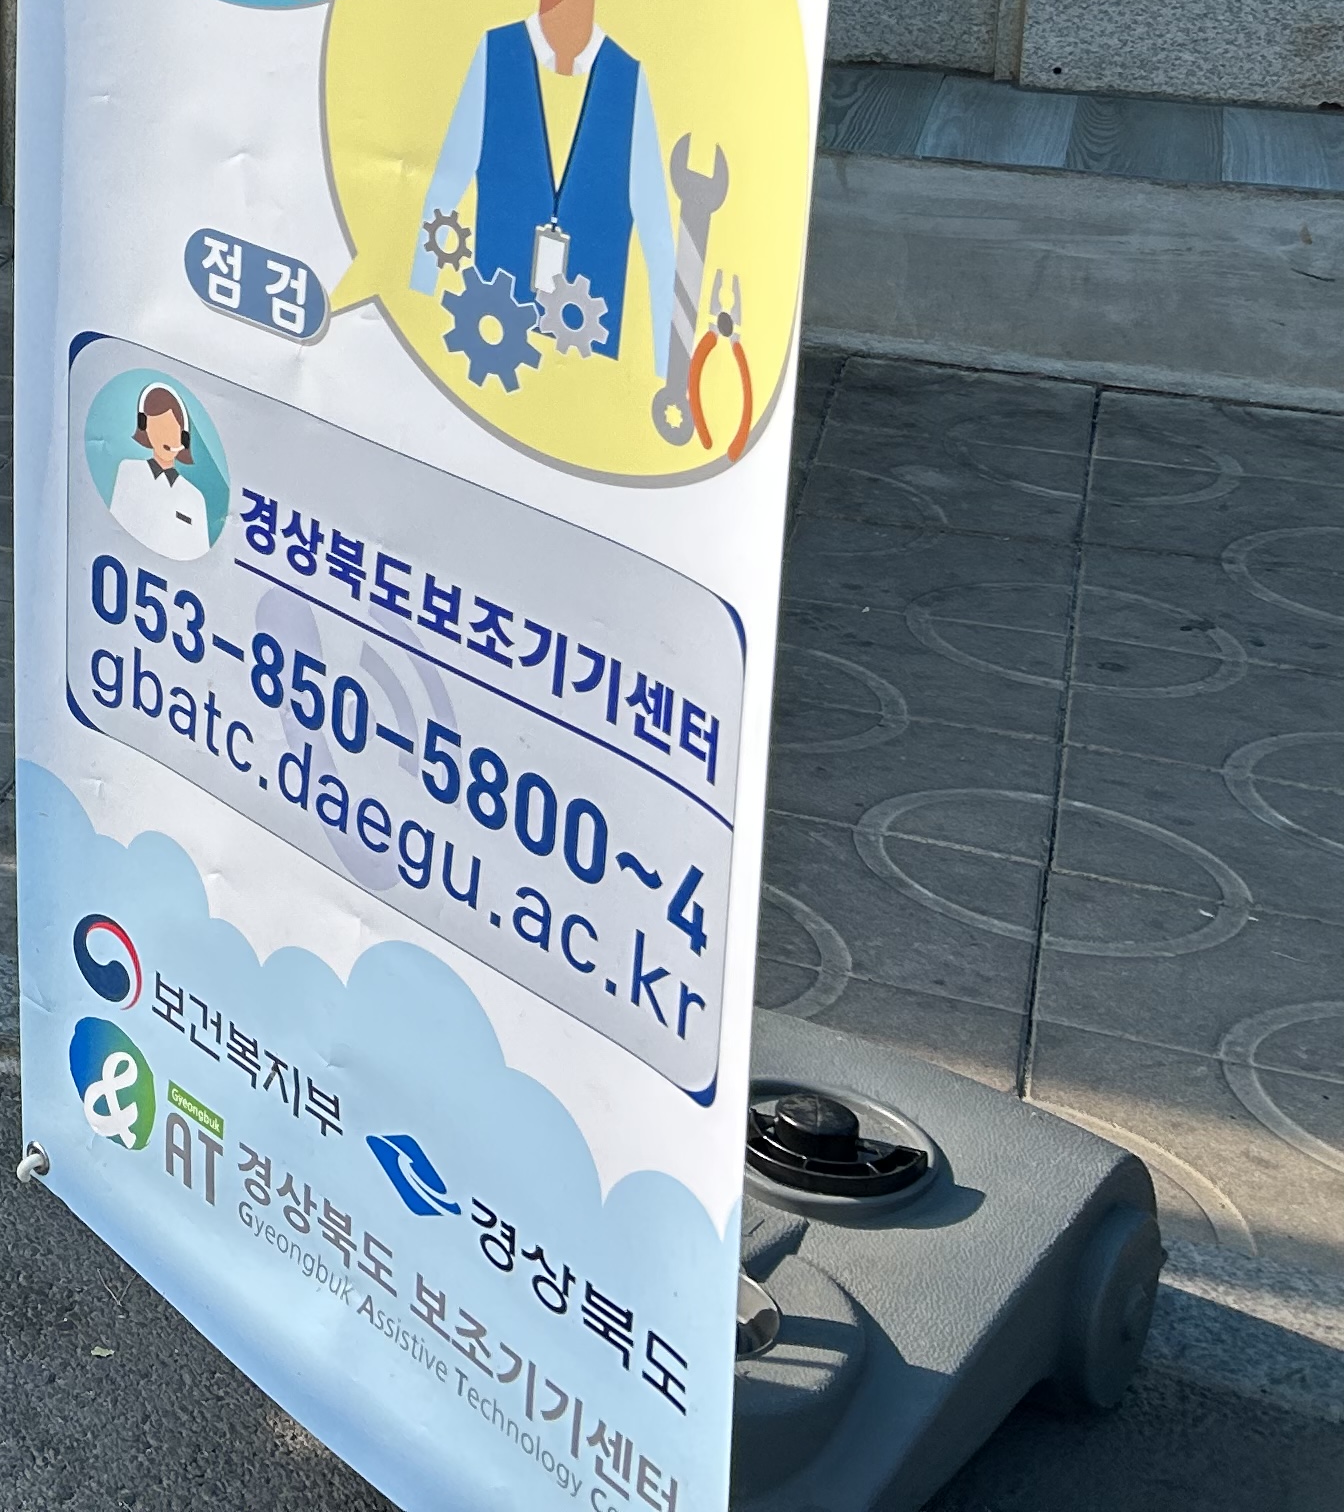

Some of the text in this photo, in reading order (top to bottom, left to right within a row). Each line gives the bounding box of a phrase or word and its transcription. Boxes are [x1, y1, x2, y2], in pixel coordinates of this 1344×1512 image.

[90, 553, 709, 957] 053-850-5800~4
[240, 487, 721, 786] 경상북도보조기기센터
[90, 646, 708, 1040] gbatc.daegu.ac.kr
[151, 971, 344, 1138] 보건복지부
[165, 1112, 224, 1206] AT
[170, 1087, 221, 1134] Gyeongbuk
[237, 1141, 679, 1512] 경상북도 보조기기센터
[238, 1200, 583, 1498] Gyeongbuk Assistive Technology
[469, 1195, 689, 1417] 경상북도
